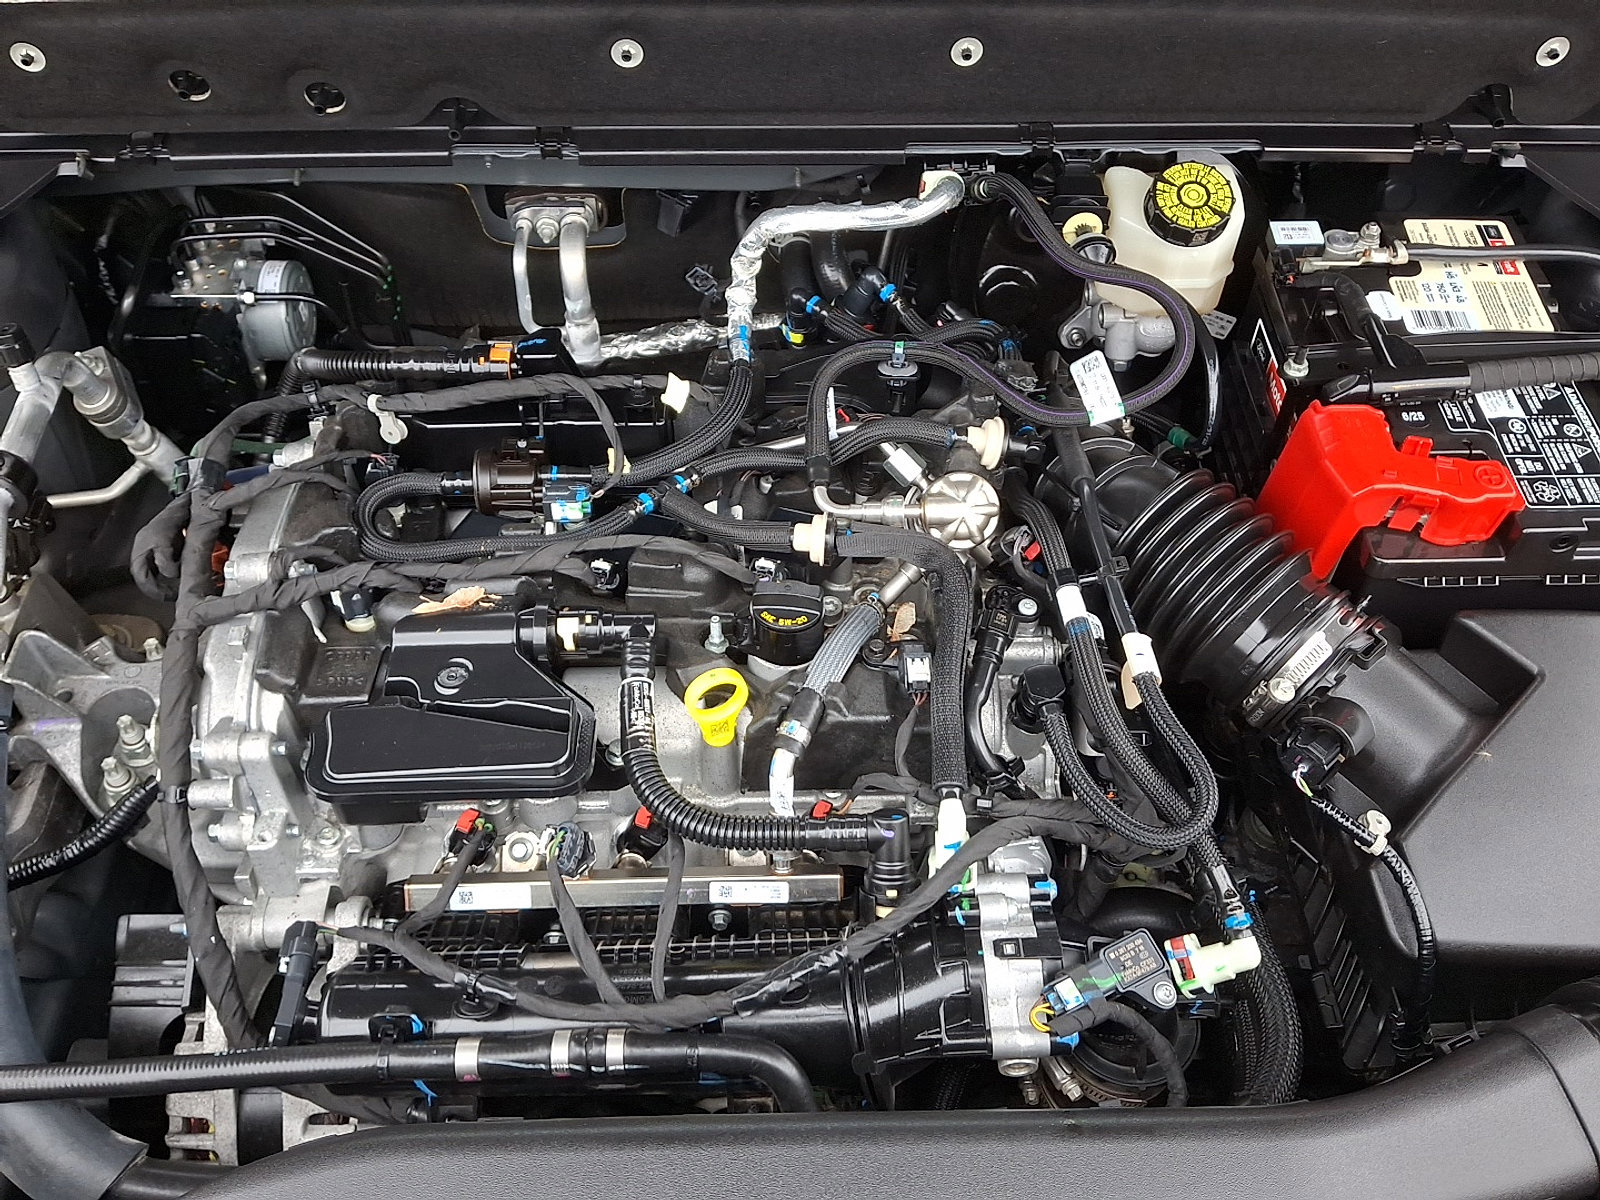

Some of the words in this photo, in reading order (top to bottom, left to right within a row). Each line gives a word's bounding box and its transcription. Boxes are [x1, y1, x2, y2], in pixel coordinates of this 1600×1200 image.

[1401, 411, 1425, 422] 6/25
[760, 610, 777, 624] SAE
[778, 615, 808, 627] 5W-20
